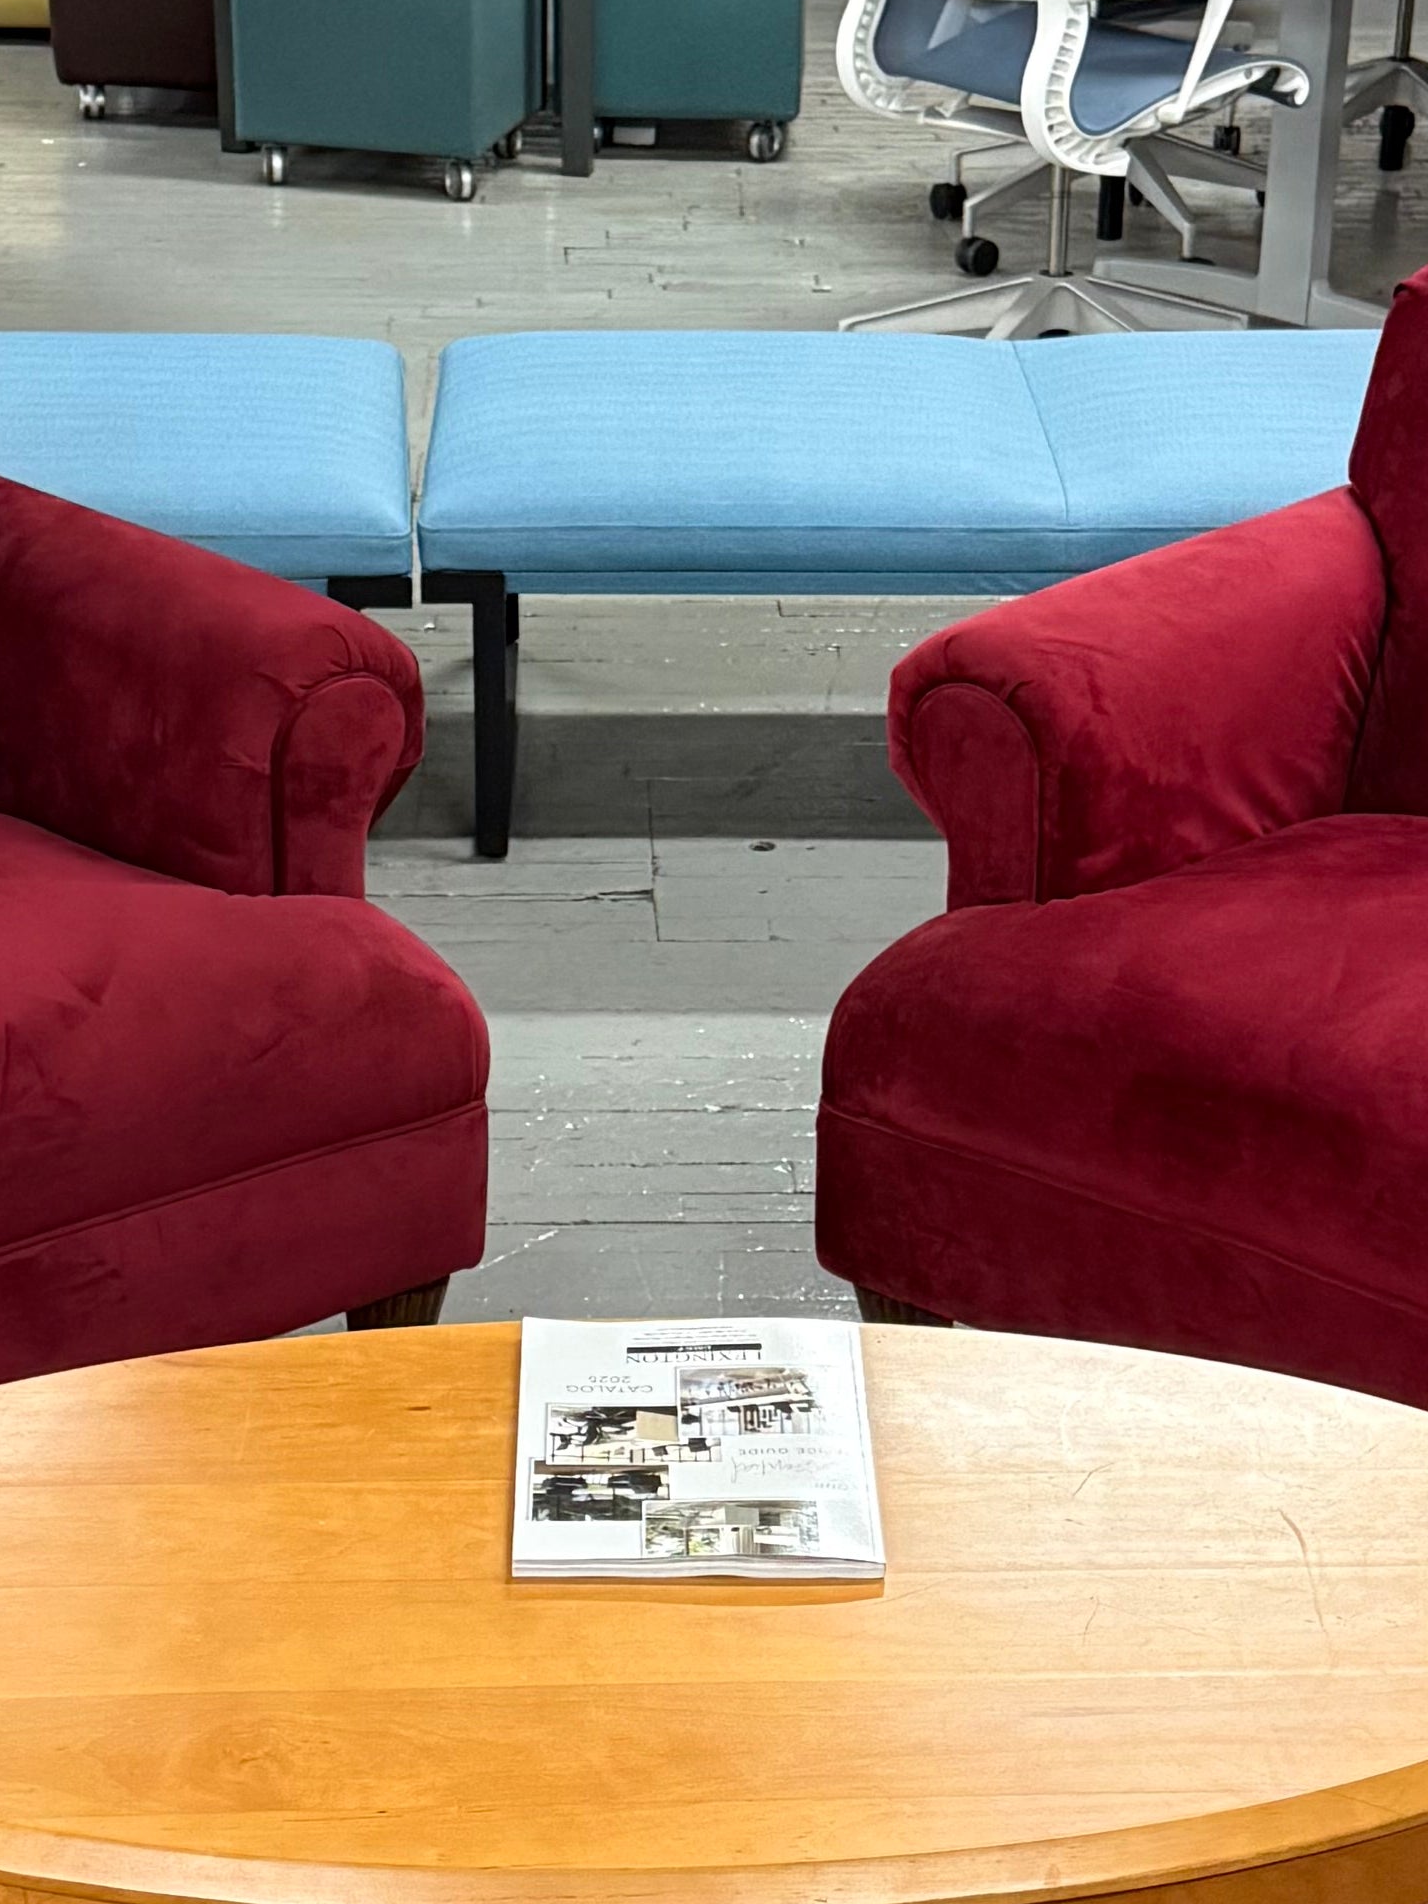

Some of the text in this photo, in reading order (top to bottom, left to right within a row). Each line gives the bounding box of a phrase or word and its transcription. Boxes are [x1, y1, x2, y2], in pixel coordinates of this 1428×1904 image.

[626, 1350, 762, 1364] LEXINGTON
[566, 1384, 653, 1393] CATALOG
[738, 1447, 789, 1456] GUIDE
